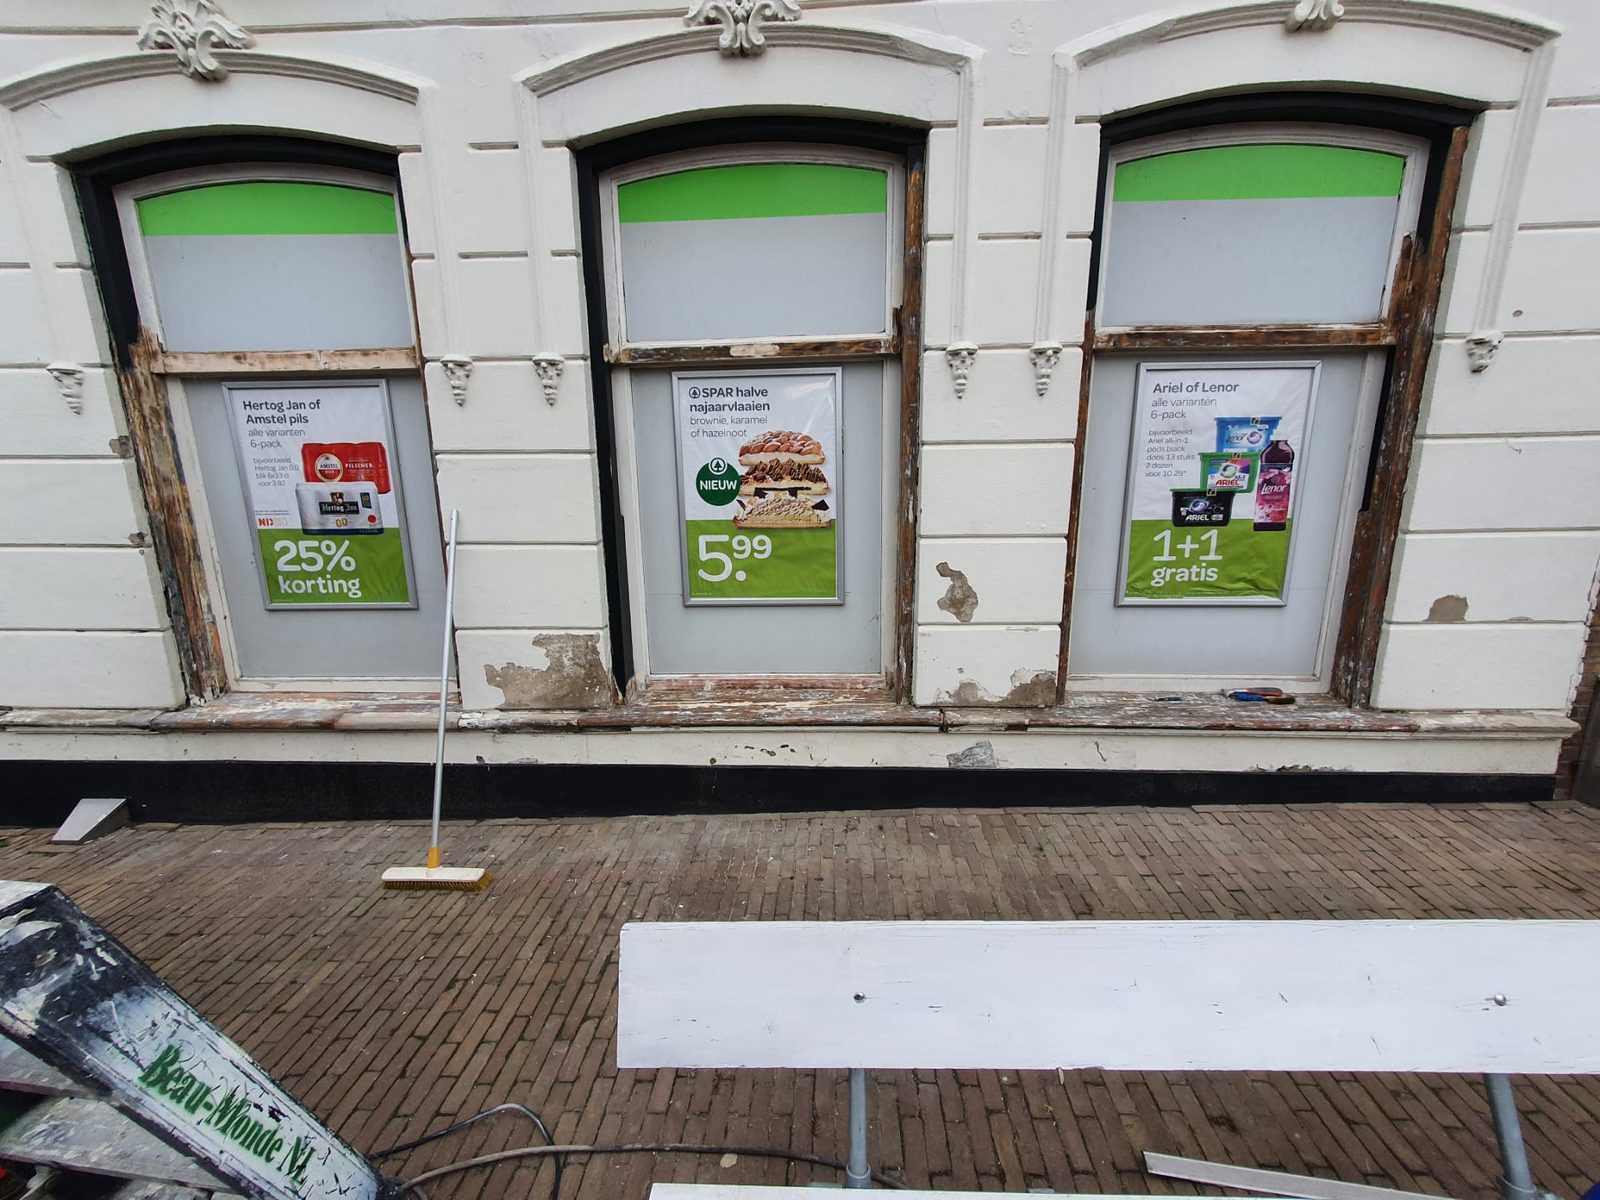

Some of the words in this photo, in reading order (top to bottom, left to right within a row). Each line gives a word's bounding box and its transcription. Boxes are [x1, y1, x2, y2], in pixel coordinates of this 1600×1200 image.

[702, 387, 734, 398] SPAR
[736, 386, 768, 398] halve
[1152, 382, 1183, 394] Ariel
[1186, 382, 1200, 393] of
[1202, 382, 1240, 393] Lenor
[243, 400, 284, 412] Hertog
[286, 400, 306, 411] Jan
[308, 399, 320, 410] of
[690, 402, 770, 414] najaarvlaaien
[1152, 398, 1168, 407] alle
[1170, 398, 1217, 407] varianten
[246, 414, 287, 424] Amstel
[290, 414, 308, 426] pils
[1150, 410, 1186, 420] 6-pack
[690, 416, 728, 426] brownie,
[730, 416, 768, 424] karamel
[248, 428, 264, 437] alle
[265, 428, 306, 437] varianten
[690, 428, 700, 438] of
[702, 428, 747, 438] hazelnoot
[1148, 429, 1192, 437] bijvoorbeeld
[250, 440, 282, 450] 6-pack
[700, 480, 738, 490] NIEUW
[1261, 484, 1287, 494] Lenor
[320, 503, 344, 512] Hertog
[1152, 528, 1223, 562] 1+1
[274, 539, 356, 572] 25%
[1151, 562, 1218, 587] gratis
[278, 575, 362, 598] korting
[138, 1044, 283, 1163] Beau-Monde
